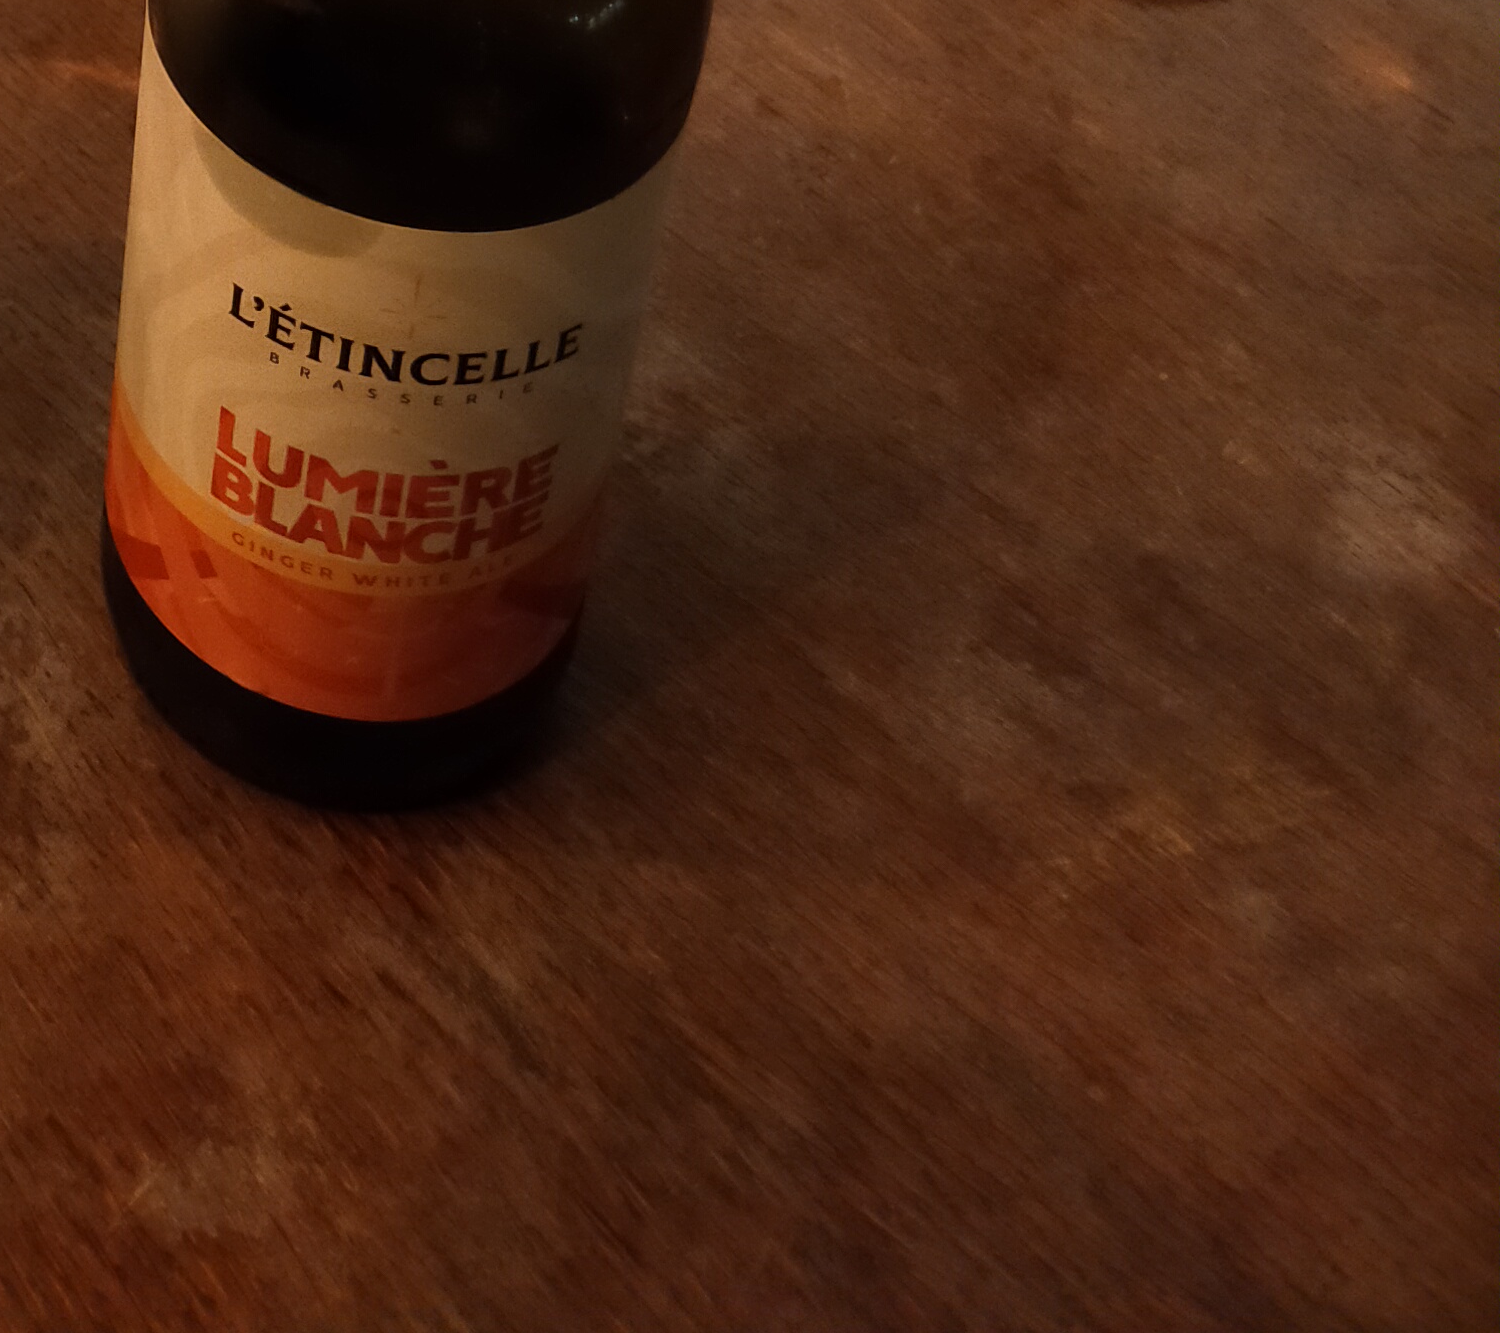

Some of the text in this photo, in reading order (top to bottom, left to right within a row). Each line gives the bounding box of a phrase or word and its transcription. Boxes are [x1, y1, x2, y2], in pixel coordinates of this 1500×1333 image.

[228, 282, 583, 386] L'ÉTINCELLE
[269, 351, 534, 407] BRASSERIE
[210, 451, 550, 565] BLANCHE
[217, 405, 560, 519] LUMIÈRE
[231, 531, 334, 582] GINGER
[351, 572, 452, 588] WHITE
